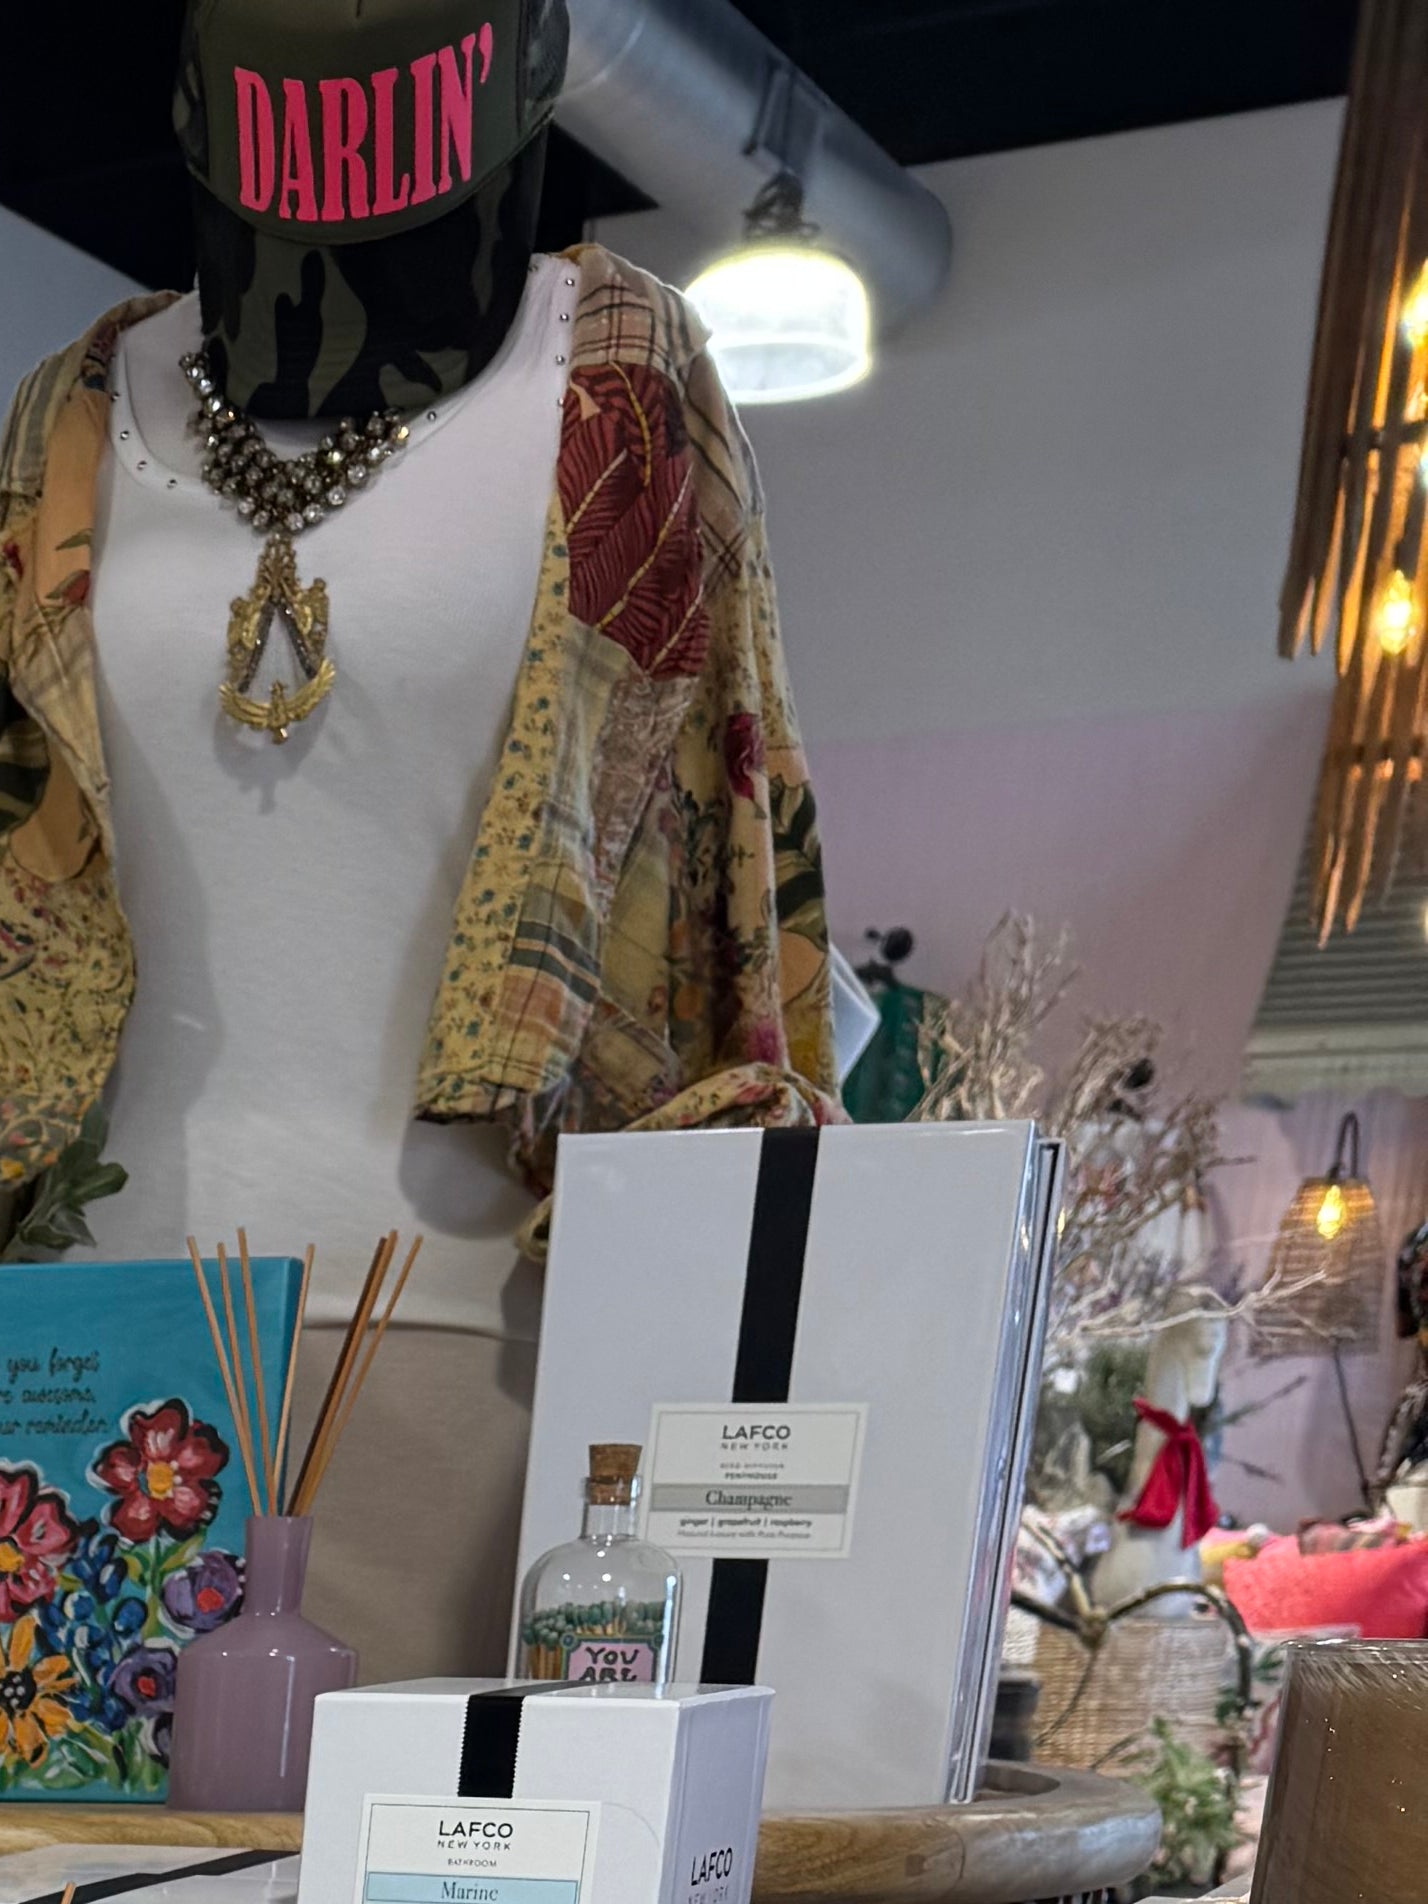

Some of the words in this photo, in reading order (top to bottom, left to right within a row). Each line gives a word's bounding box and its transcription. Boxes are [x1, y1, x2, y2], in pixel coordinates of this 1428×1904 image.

[234, 22, 493, 222] DARLIN'
[722, 1425, 791, 1440] LAFCO
[720, 1442, 749, 1450] NEW
[754, 1442, 789, 1450] YORK
[705, 1489, 793, 1511] Champagne
[586, 1646, 639, 1665] YOU
[438, 1820, 513, 1839] LAFCO
[437, 1839, 468, 1849] NEW
[474, 1841, 511, 1851] YORK
[690, 1847, 733, 1886] LAFCO
[441, 1881, 499, 1901] Marine
